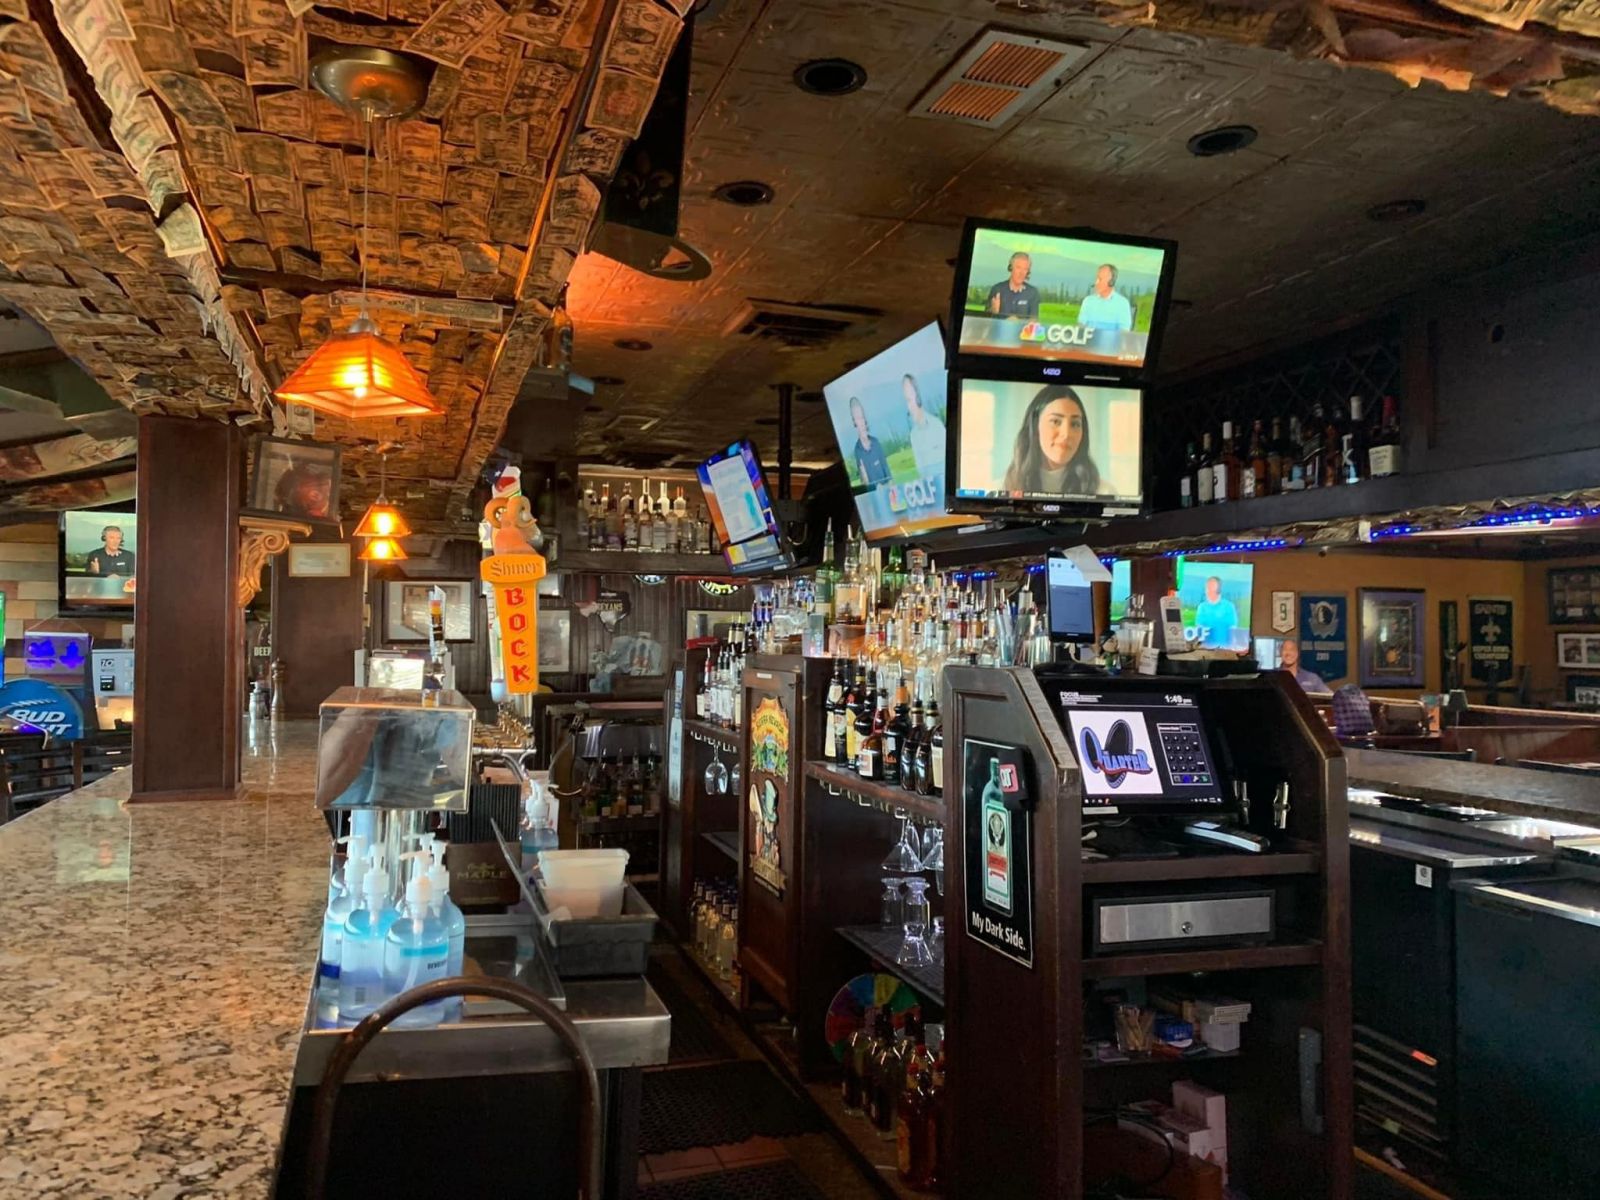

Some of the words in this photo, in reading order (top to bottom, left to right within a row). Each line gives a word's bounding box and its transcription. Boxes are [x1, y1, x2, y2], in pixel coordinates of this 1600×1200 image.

[1047, 323, 1095, 345] GOLF
[904, 476, 937, 508] GOLF
[490, 560, 539, 577] Shiner
[504, 586, 531, 684] BOCK
[1183, 624, 1211, 641] OLF
[12, 709, 66, 723] BUD
[456, 870, 508, 880] MAPLE
[972, 911, 984, 934] My
[985, 919, 1004, 940] Dark
[1005, 928, 1026, 951] Side.
